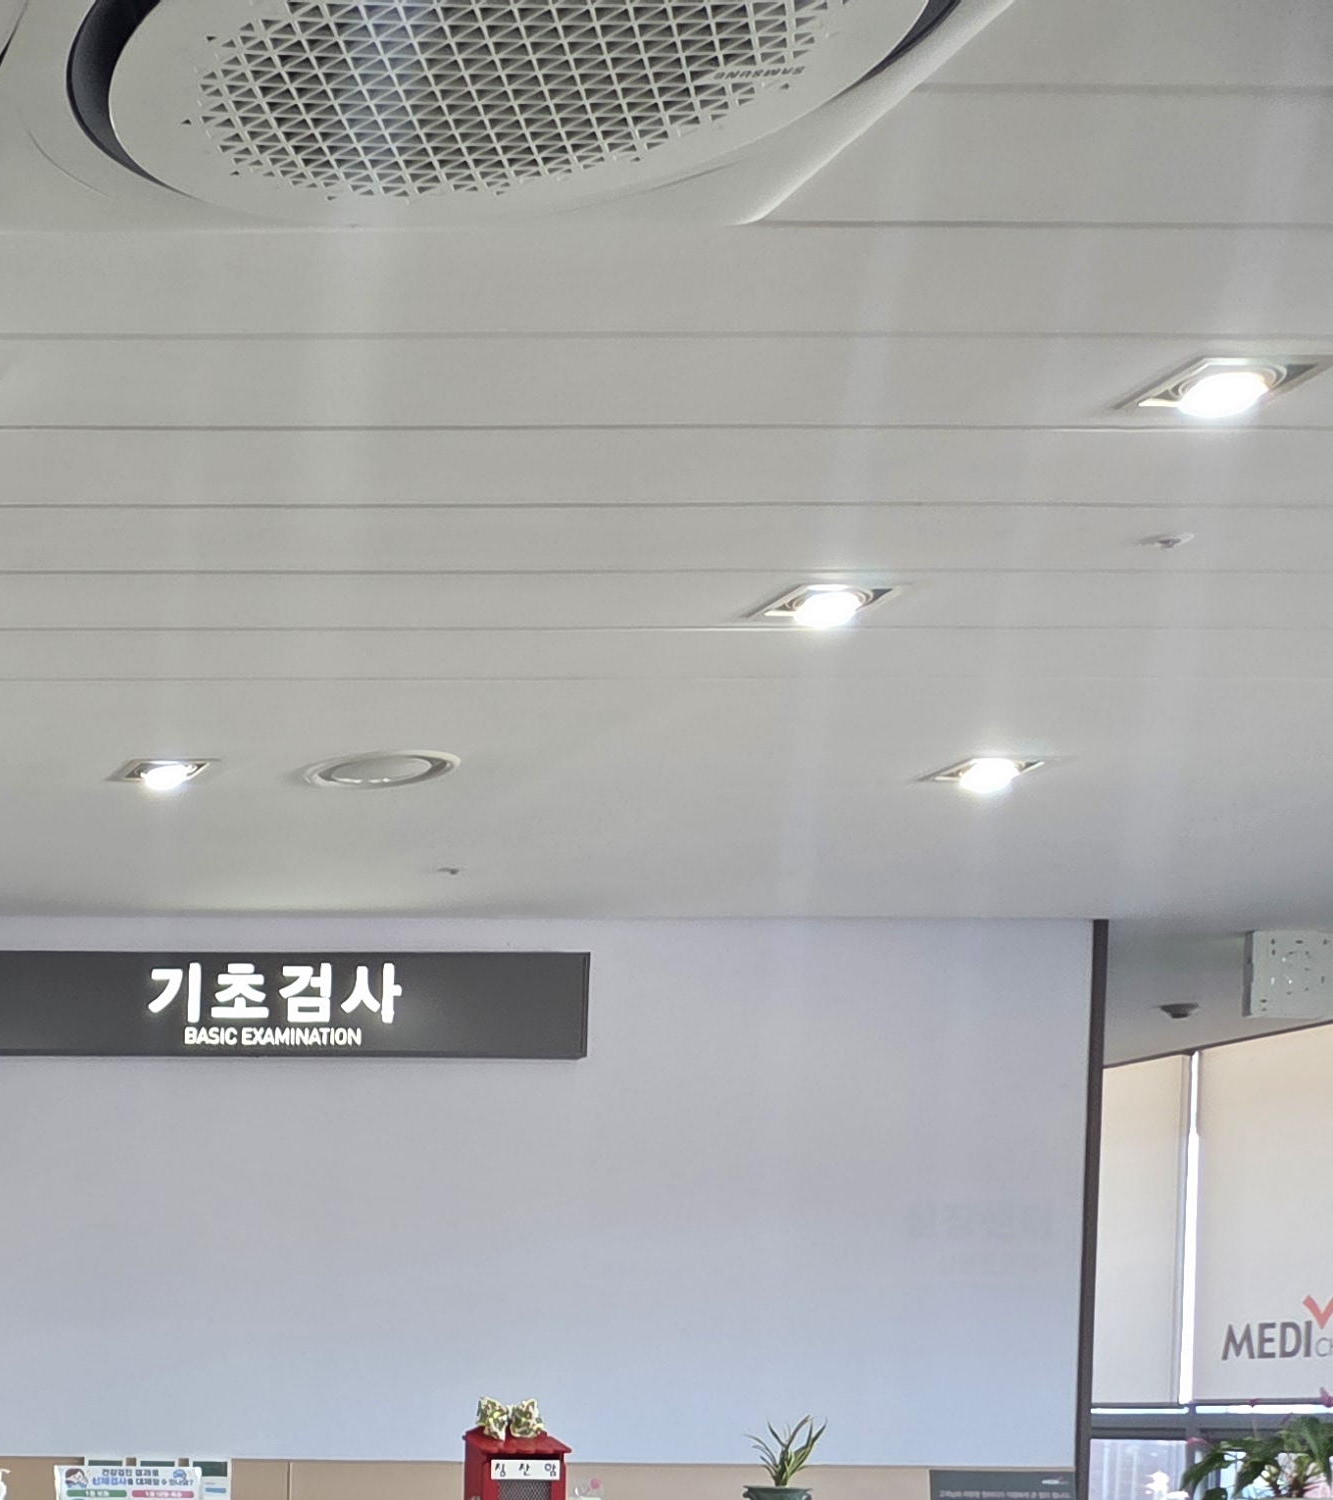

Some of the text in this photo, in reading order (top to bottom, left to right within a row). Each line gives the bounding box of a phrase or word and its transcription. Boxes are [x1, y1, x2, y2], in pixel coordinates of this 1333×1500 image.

[147, 962, 402, 1023] 기초검사
[184, 1027, 362, 1046] BASIC EXAMINATION
